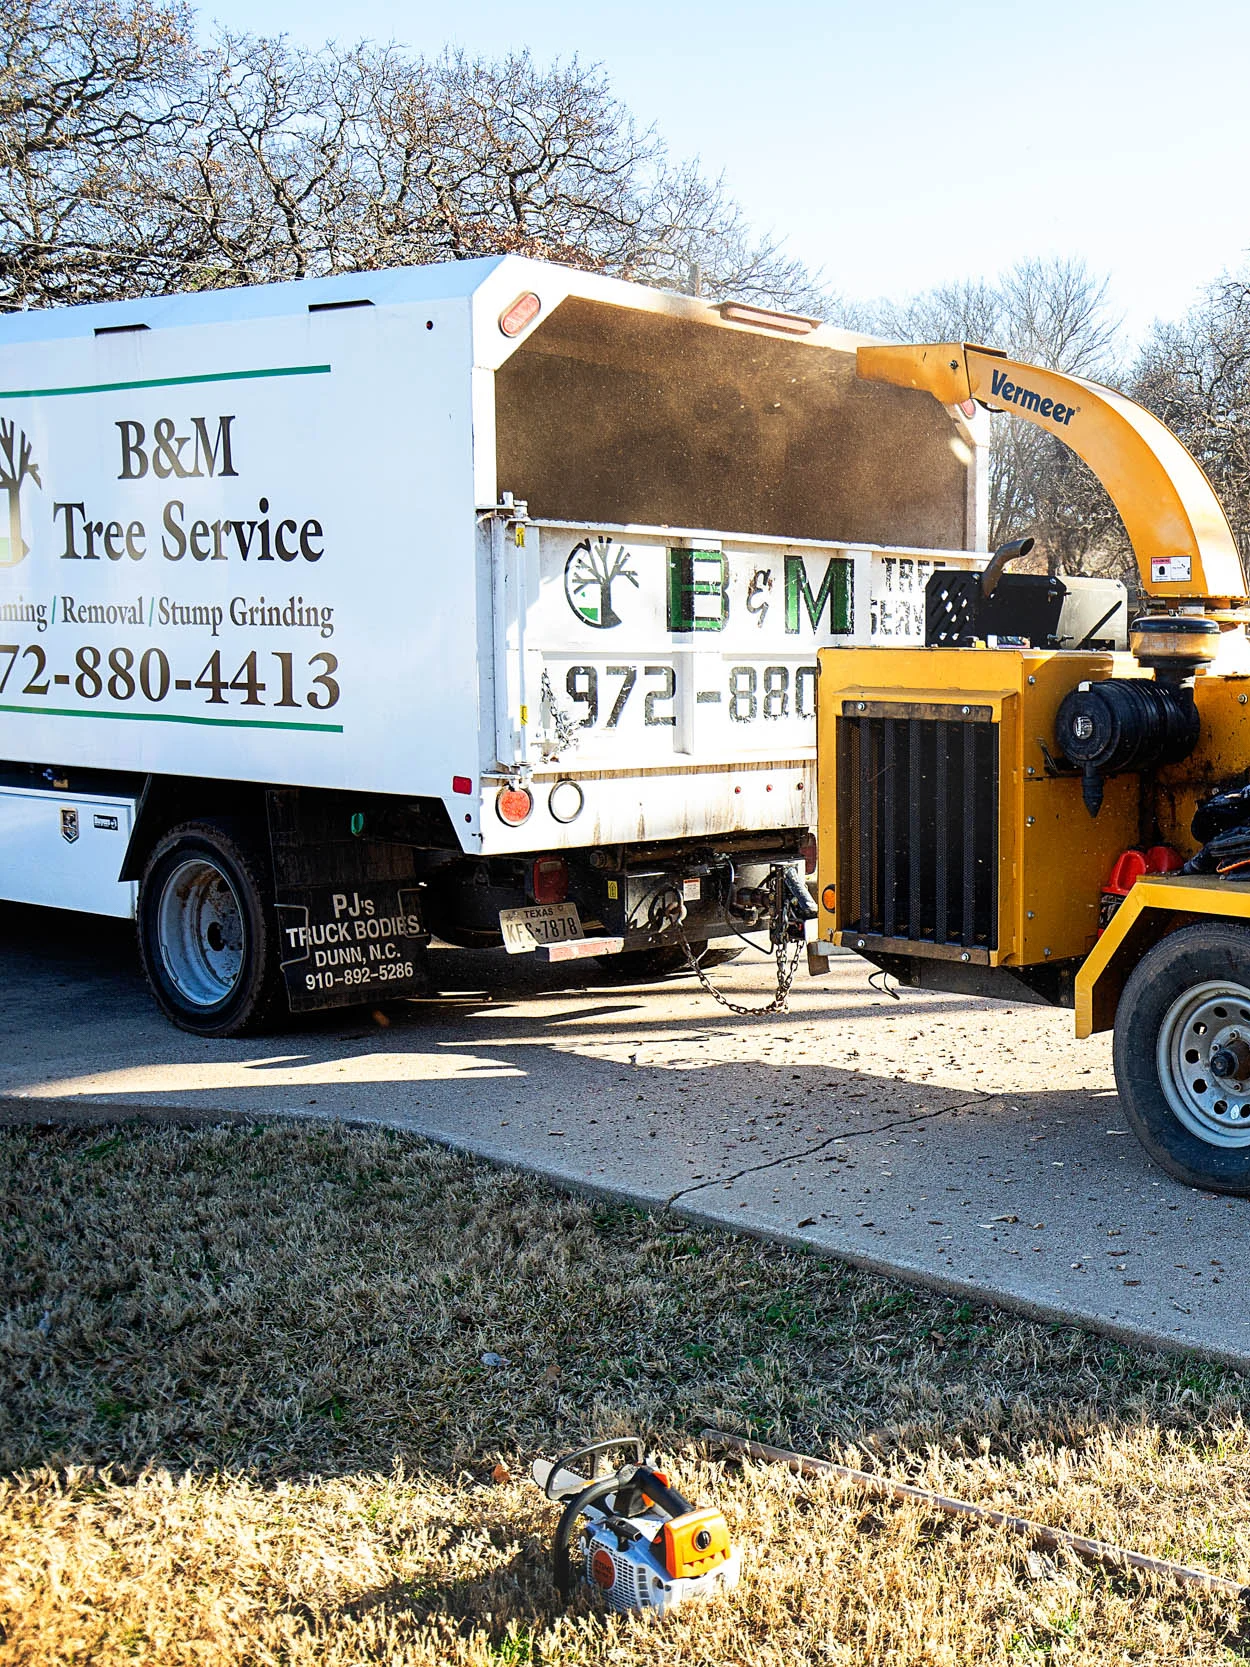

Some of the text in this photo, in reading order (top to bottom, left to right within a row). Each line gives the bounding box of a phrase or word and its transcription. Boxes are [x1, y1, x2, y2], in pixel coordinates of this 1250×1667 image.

[114, 415, 240, 480] B&M
[53, 497, 325, 562] Tree Service
[666, 547, 730, 633] B
[784, 555, 855, 635] M
[881, 557, 946, 592] TRE
[0, 594, 48, 633] ming
[61, 595, 145, 625] Removal
[158, 596, 223, 637] Stump
[229, 596, 335, 639] Grinding
[332, 892, 376, 919] PJ's
[523, 907, 554, 919] TEXAS
[285, 914, 421, 948] TRUCK BODIES
[315, 942, 401, 967] DUNN, N.C.
[305, 961, 414, 991] 910-892-5286
